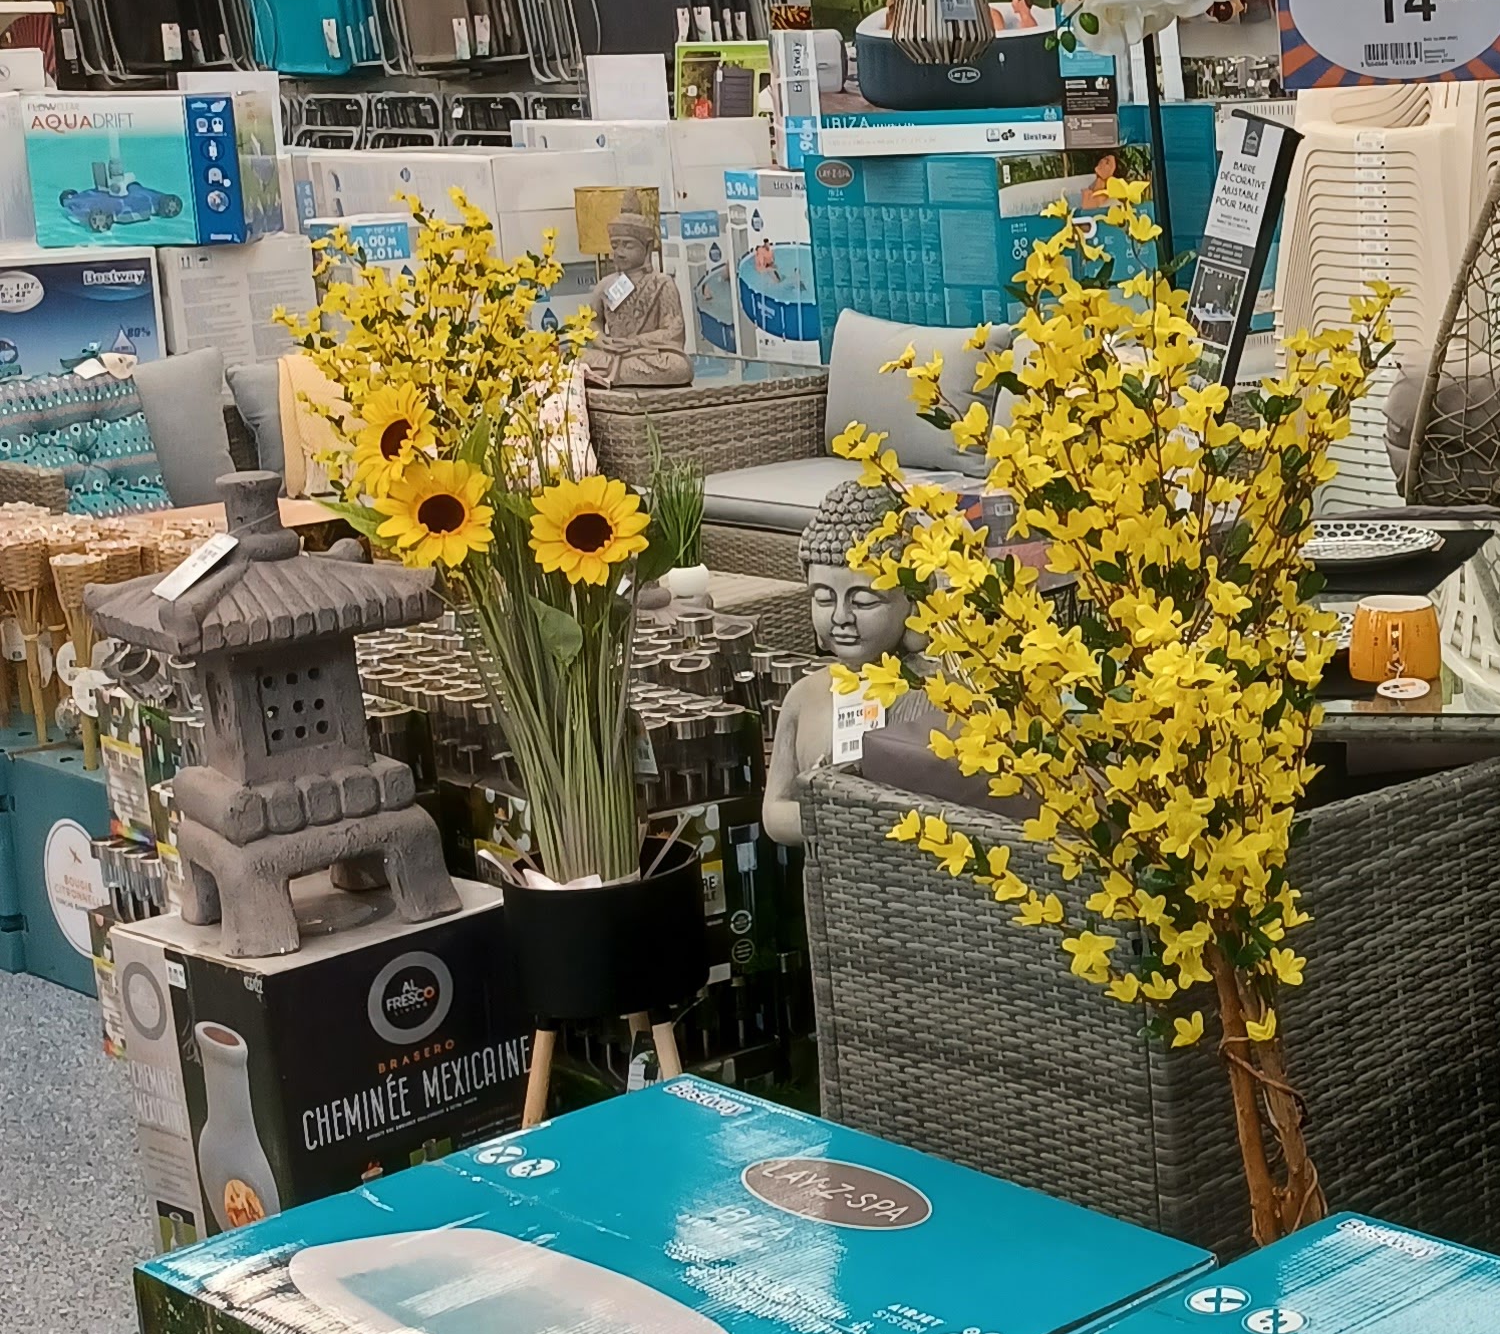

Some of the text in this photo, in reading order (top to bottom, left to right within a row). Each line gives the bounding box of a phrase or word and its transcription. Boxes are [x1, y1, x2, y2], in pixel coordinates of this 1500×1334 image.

[31, 113, 135, 133] AQUADRIFT
[825, 116, 869, 128] IBIZA
[83, 270, 147, 285] Bestway
[402, 980, 418, 993] AL
[386, 986, 435, 1011] FRESCO
[378, 1039, 455, 1074] BRASERO
[303, 1073, 411, 1151] CHEMINÉE
[422, 1035, 532, 1108] MEXICAINE
[762, 1161, 910, 1223] LAY-Z-SPA
